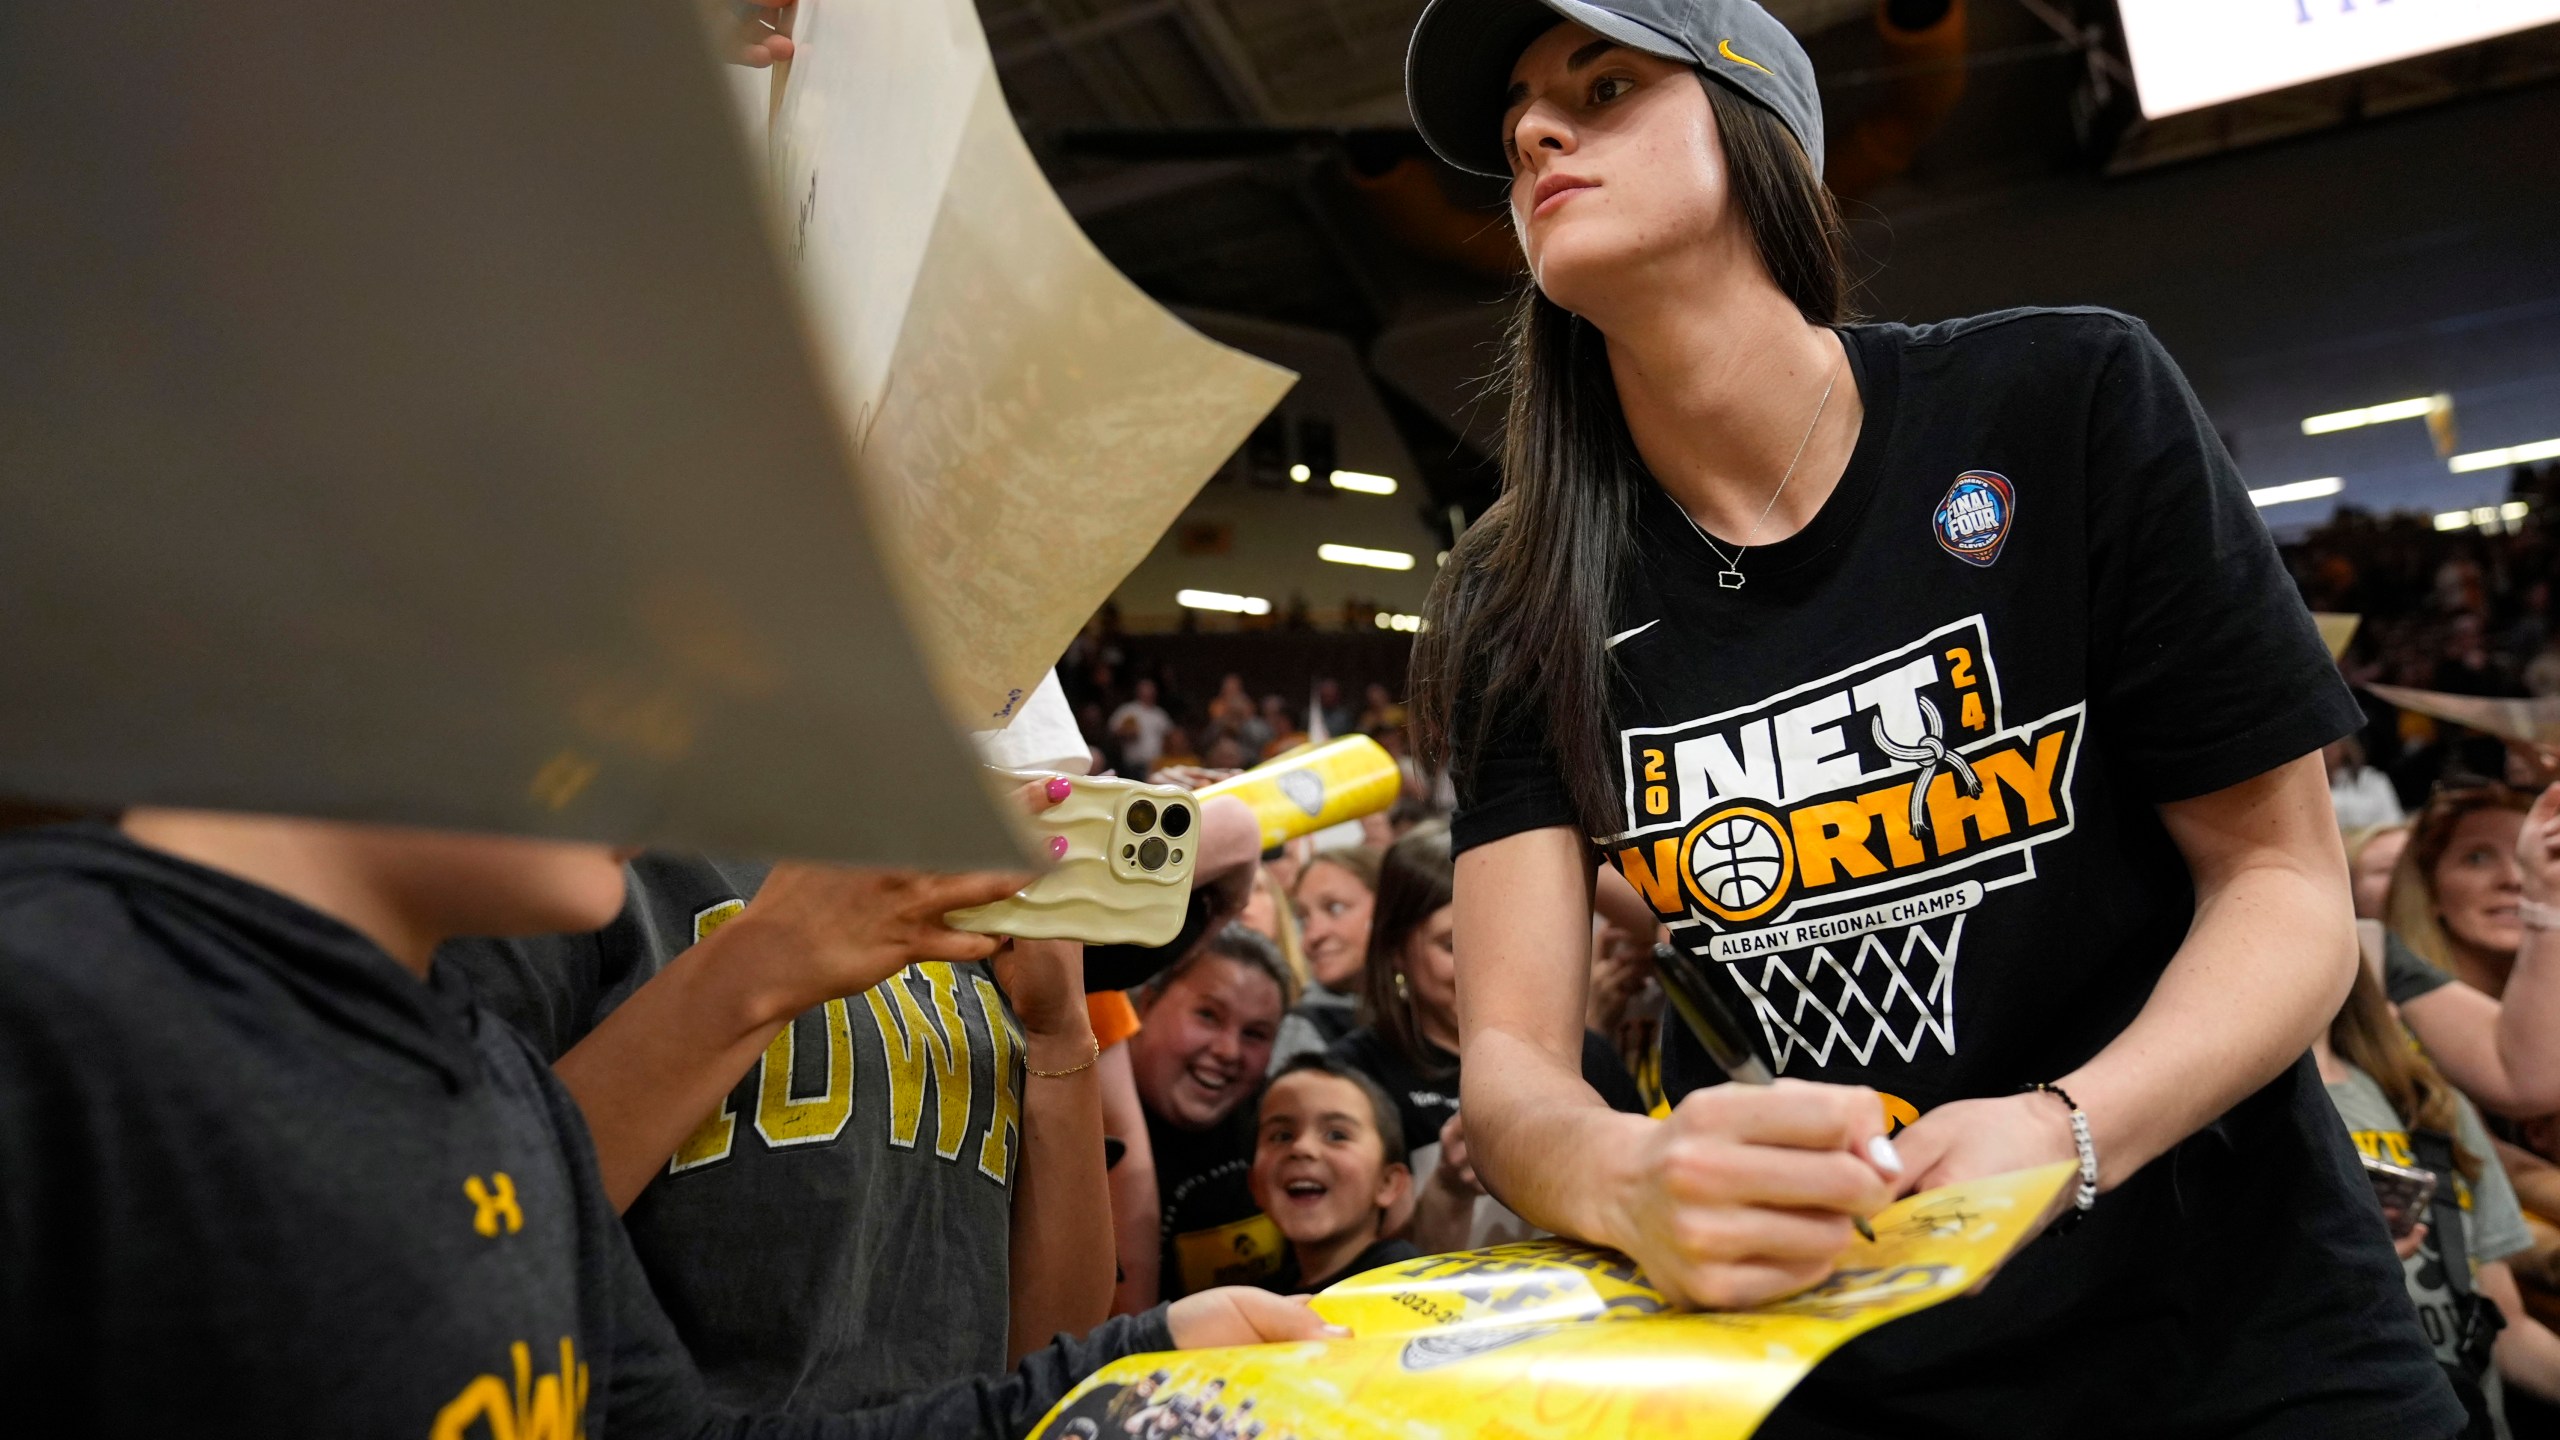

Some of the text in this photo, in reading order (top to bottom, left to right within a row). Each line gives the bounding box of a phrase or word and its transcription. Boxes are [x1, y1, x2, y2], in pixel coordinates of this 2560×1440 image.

[1946, 489, 1994, 523] FINAL
[1948, 507, 2000, 541] FOUR
[1958, 533, 1998, 549] CLEVELAND
[1673, 655, 1940, 822] NET
[1603, 730, 2066, 922] WORTHY
[1721, 889, 1967, 956] ALBANY REGIONAL CHAMPS
